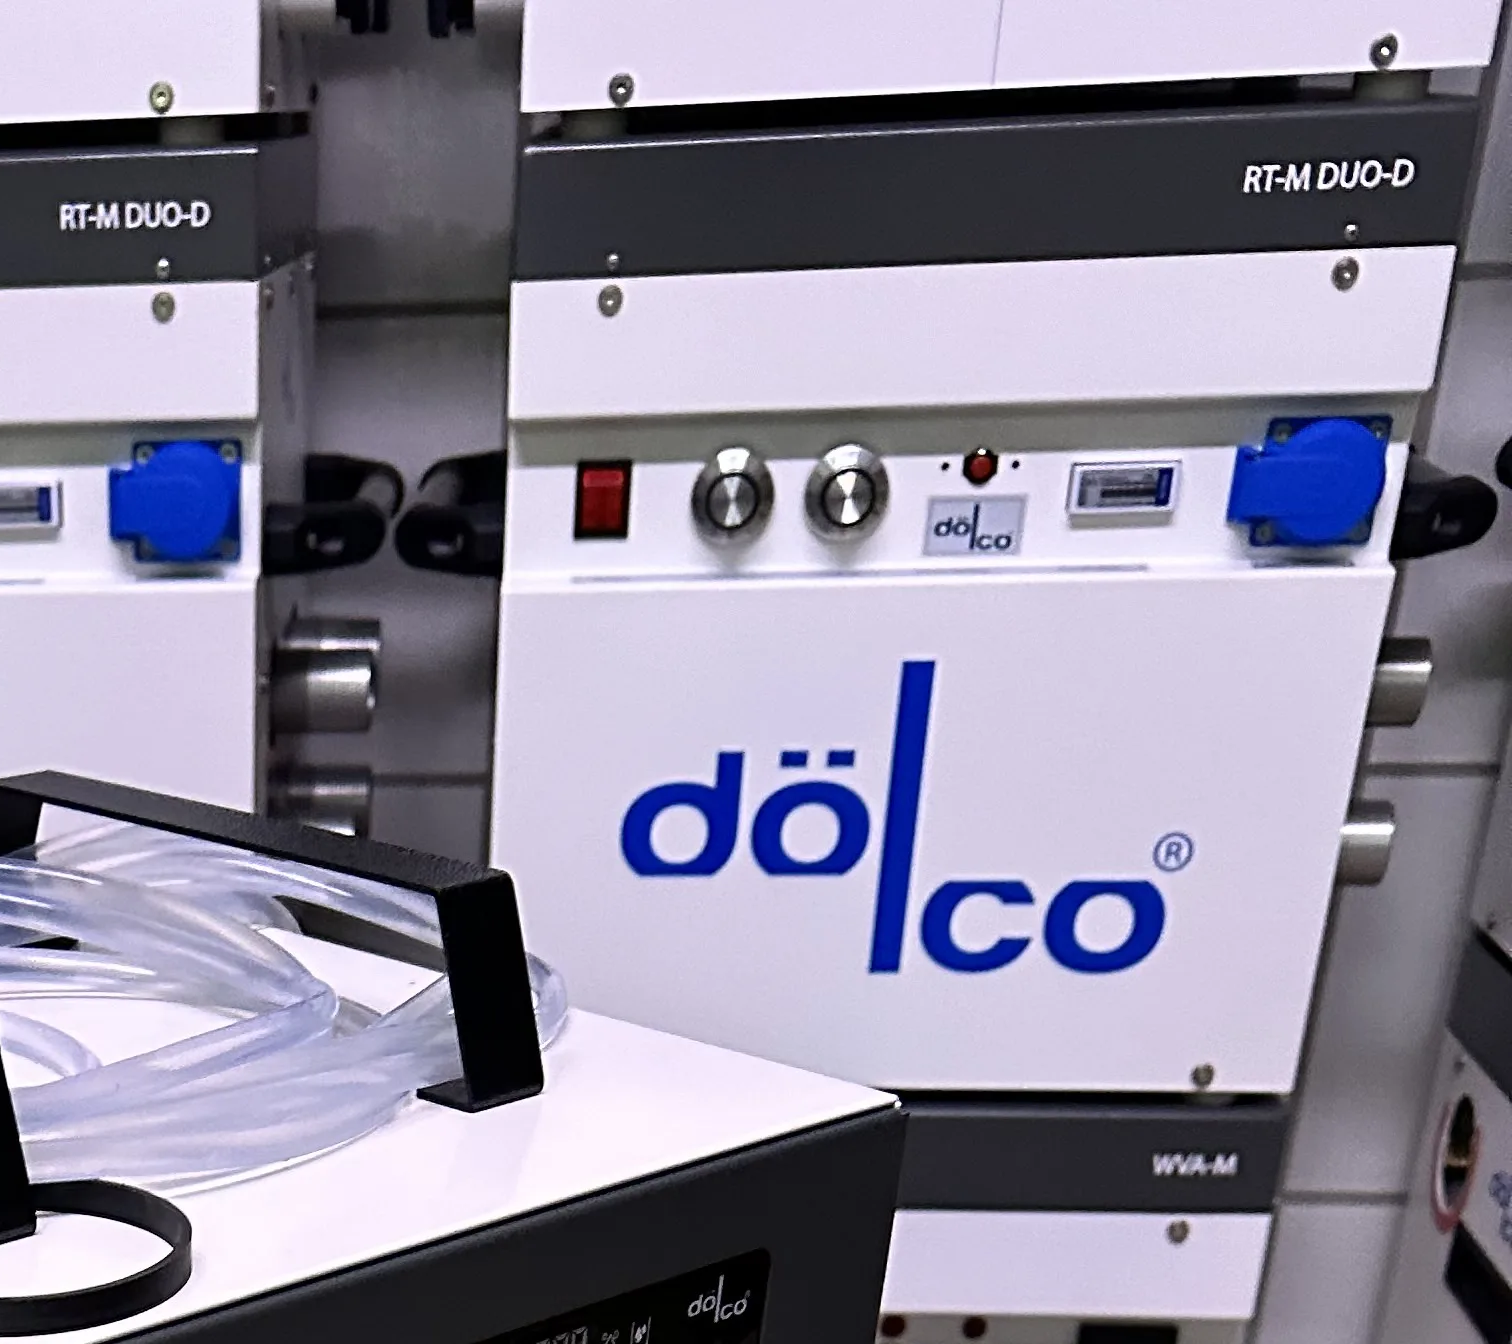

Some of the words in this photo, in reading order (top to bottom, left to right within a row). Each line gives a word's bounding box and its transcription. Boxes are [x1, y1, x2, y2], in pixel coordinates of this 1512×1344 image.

[1242, 162, 1312, 194] RT-M
[1316, 158, 1416, 190] DUO-D
[59, 202, 121, 231] RT-M
[124, 200, 212, 229] DUO-D
[1152, 1153, 1238, 1176] WVA-M
